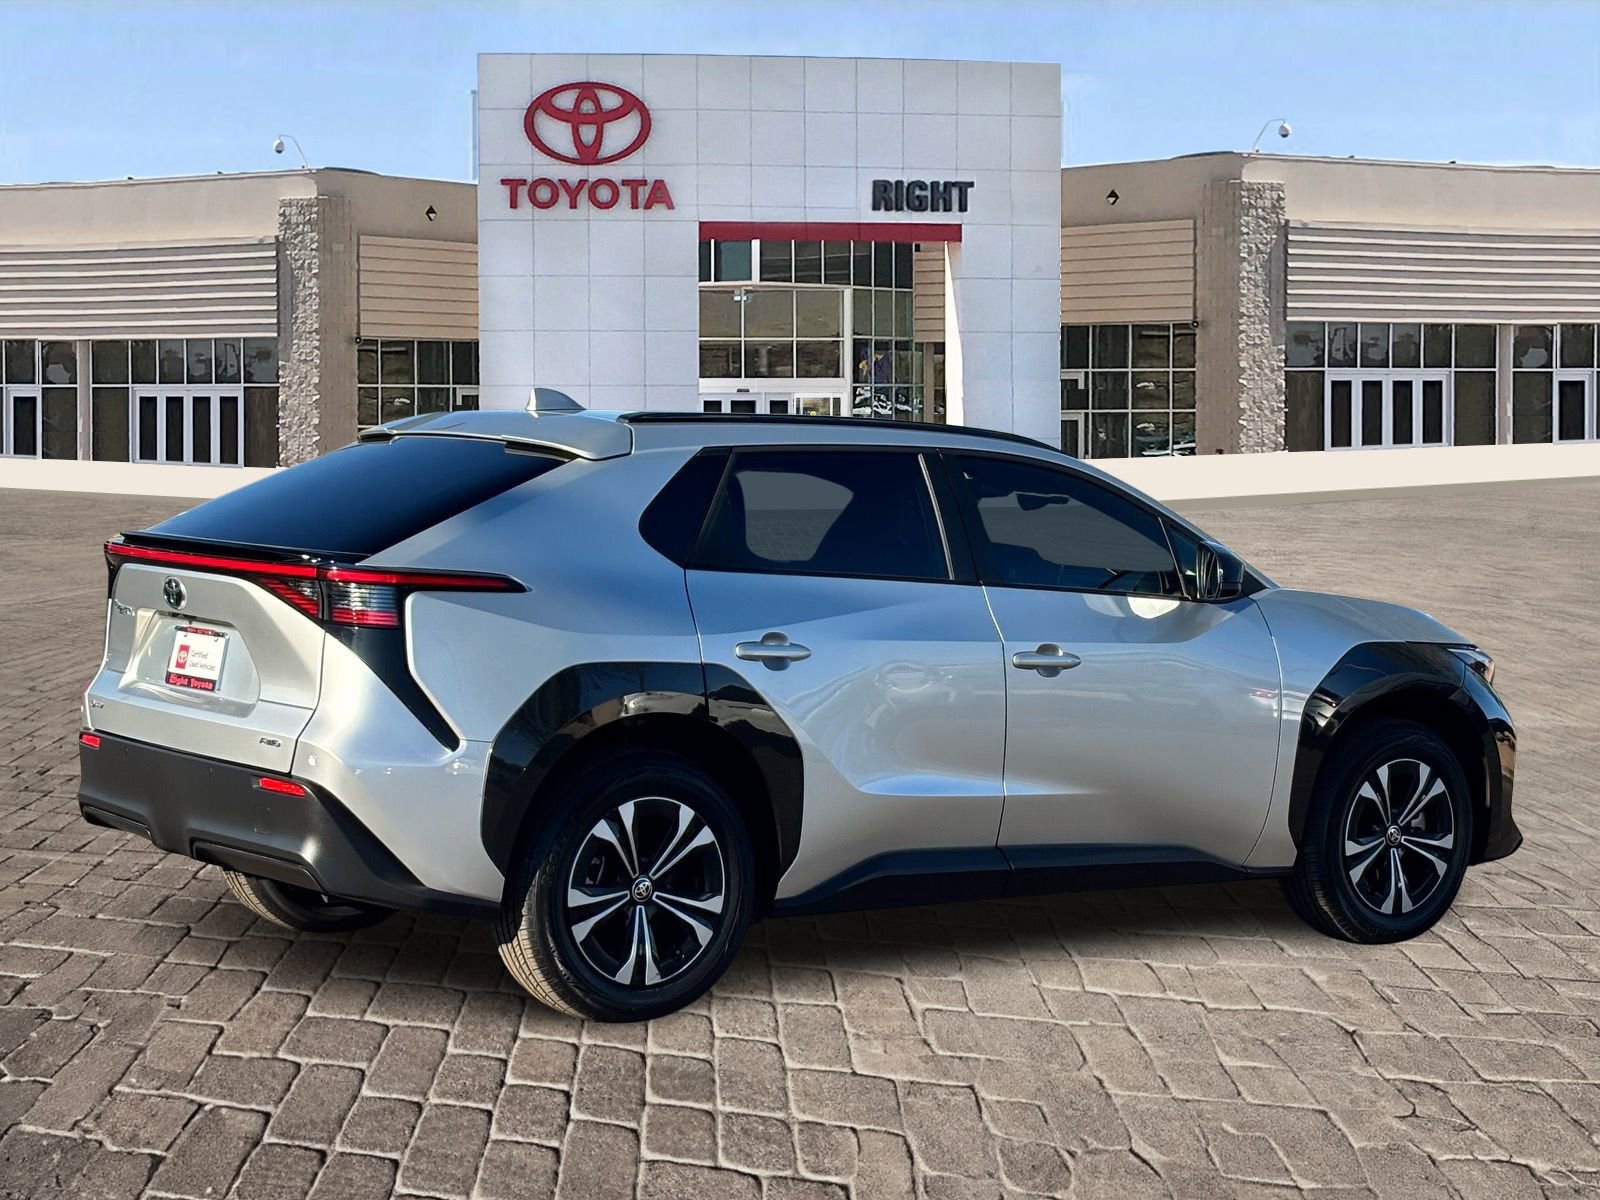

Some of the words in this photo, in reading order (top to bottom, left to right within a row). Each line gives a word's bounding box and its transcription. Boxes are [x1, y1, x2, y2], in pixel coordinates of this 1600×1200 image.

[500, 178, 675, 210] TOYOTA
[872, 179, 975, 212] RIGHT
[190, 677, 213, 690] Toyota
